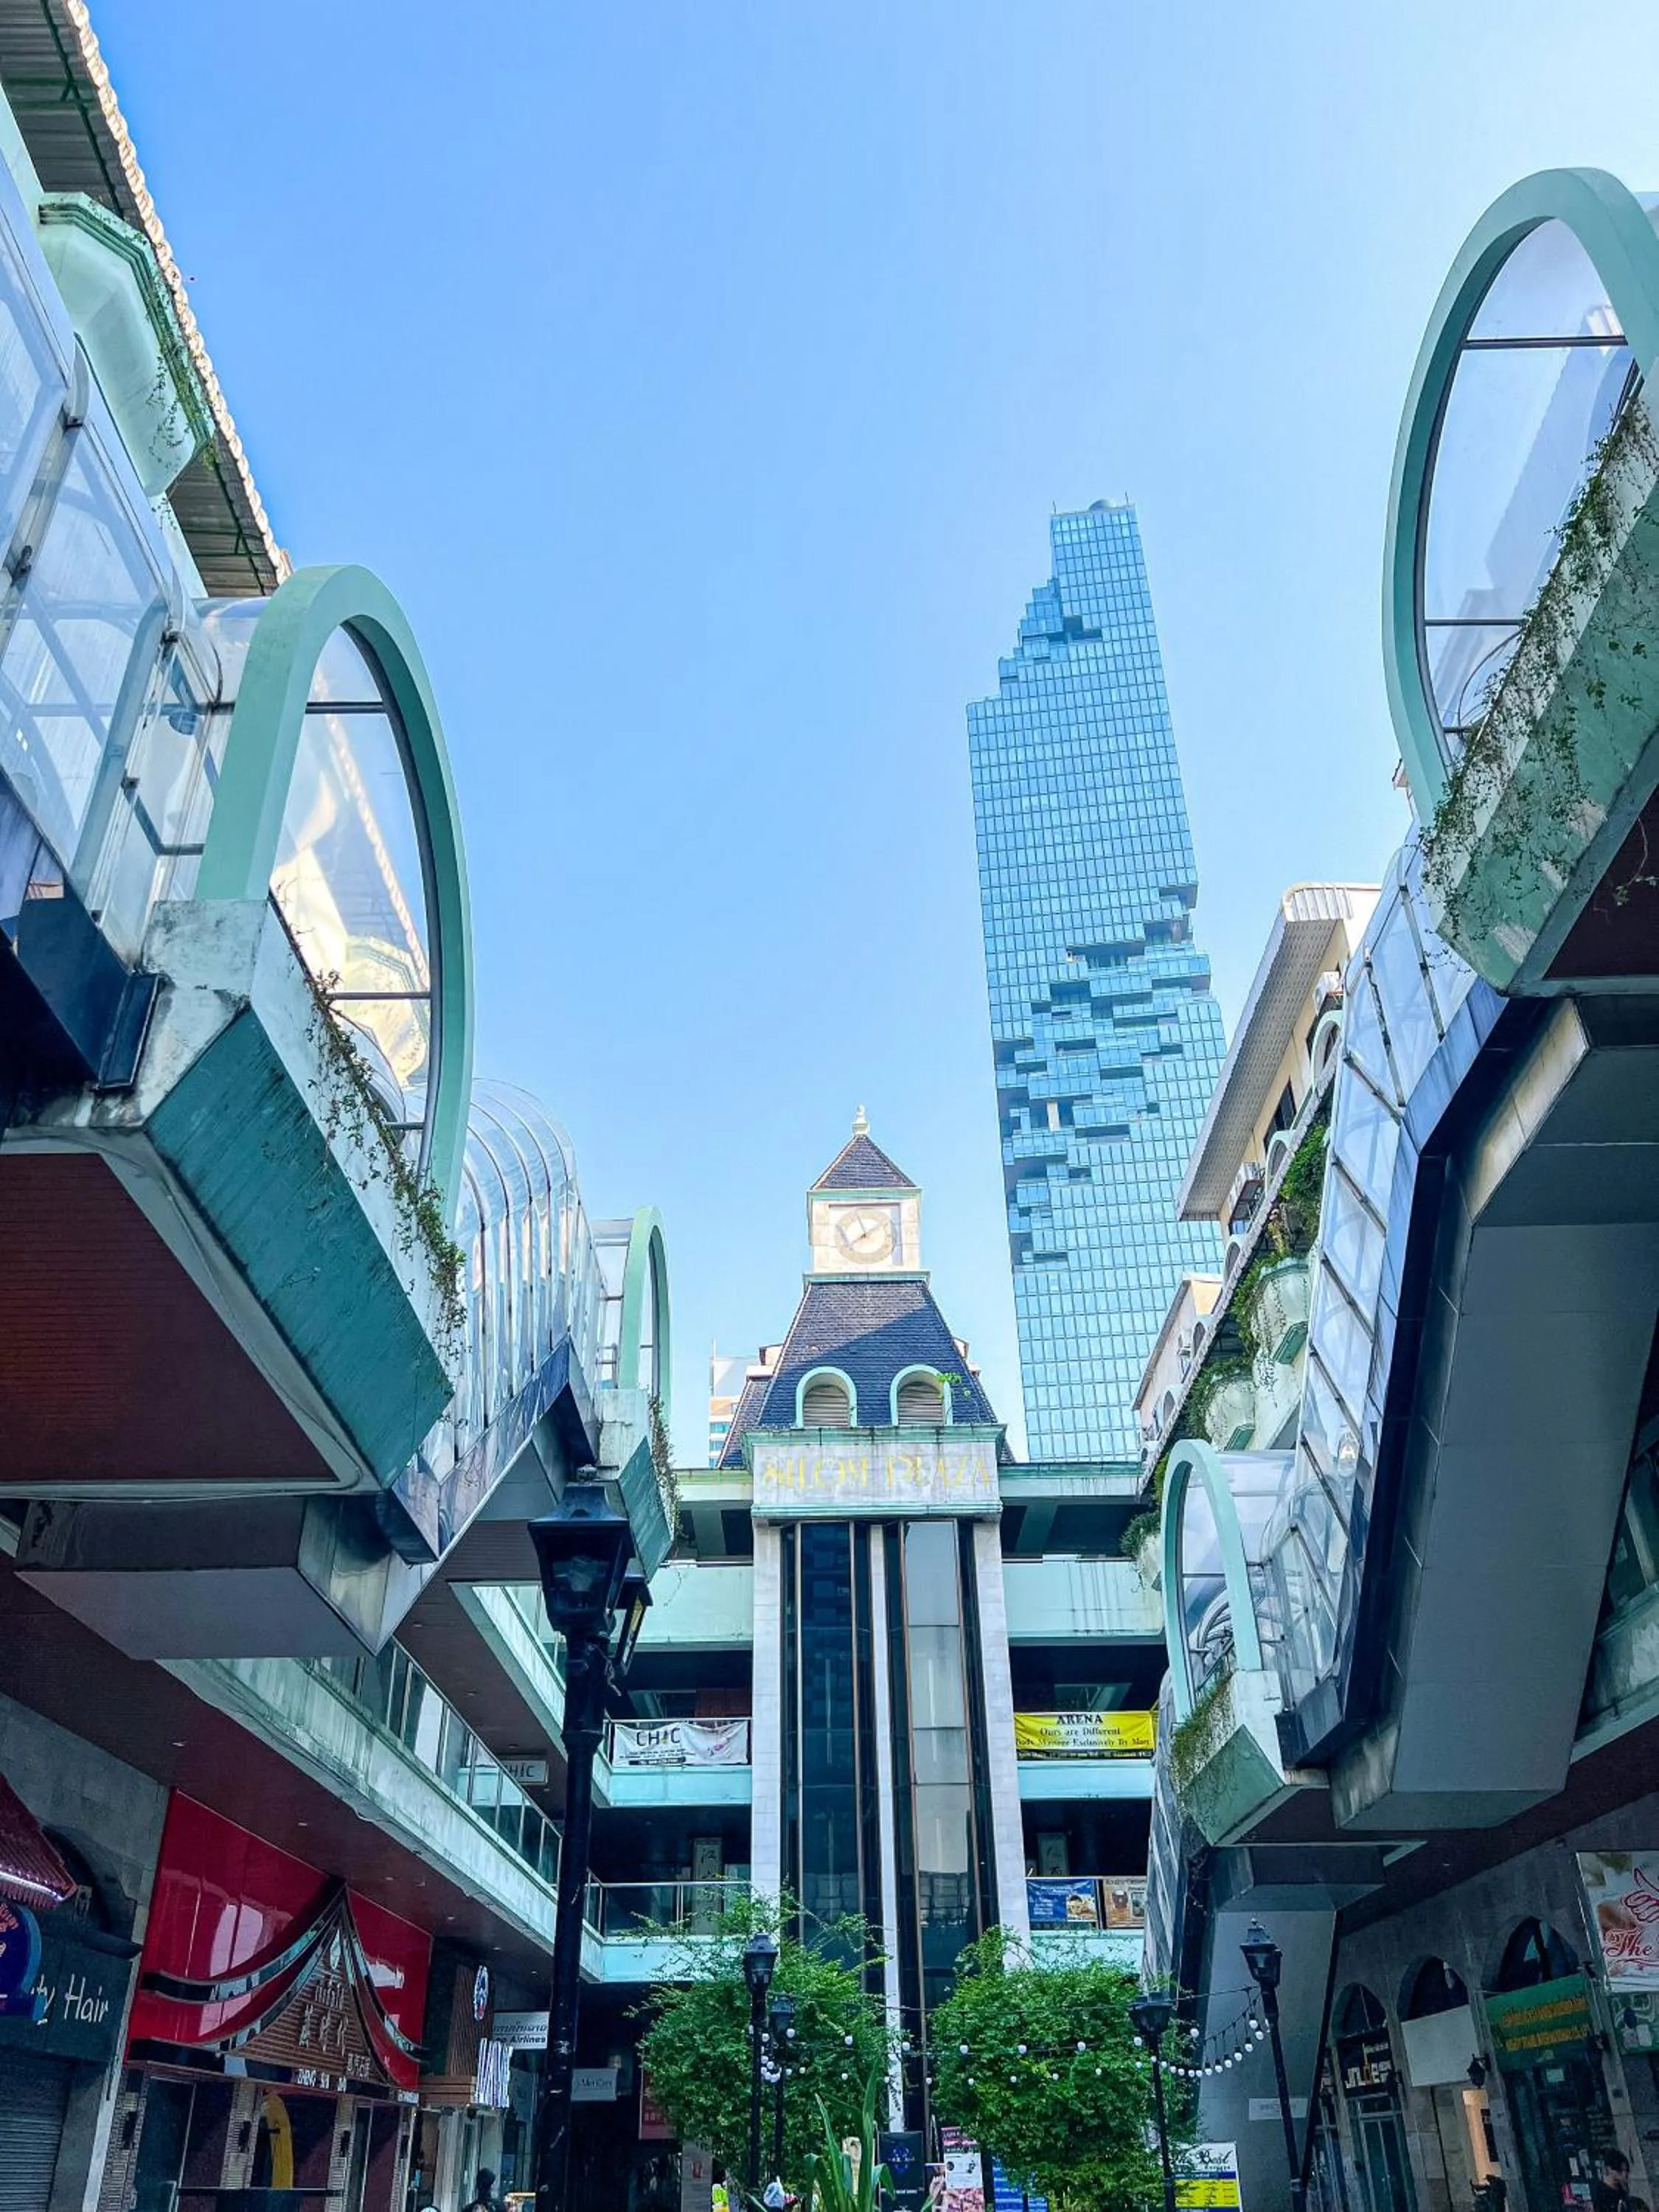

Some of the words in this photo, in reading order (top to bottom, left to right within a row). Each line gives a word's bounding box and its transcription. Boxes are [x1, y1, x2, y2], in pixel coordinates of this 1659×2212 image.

[1056, 1714, 1104, 1725] ARENA
[1040, 1728, 1062, 1736] Ours
[1082, 1727, 1121, 1736] Different
[636, 1728, 681, 1747] CHIC
[64, 1973, 109, 2023] Hair
[509, 2034, 546, 2044] Airlines
